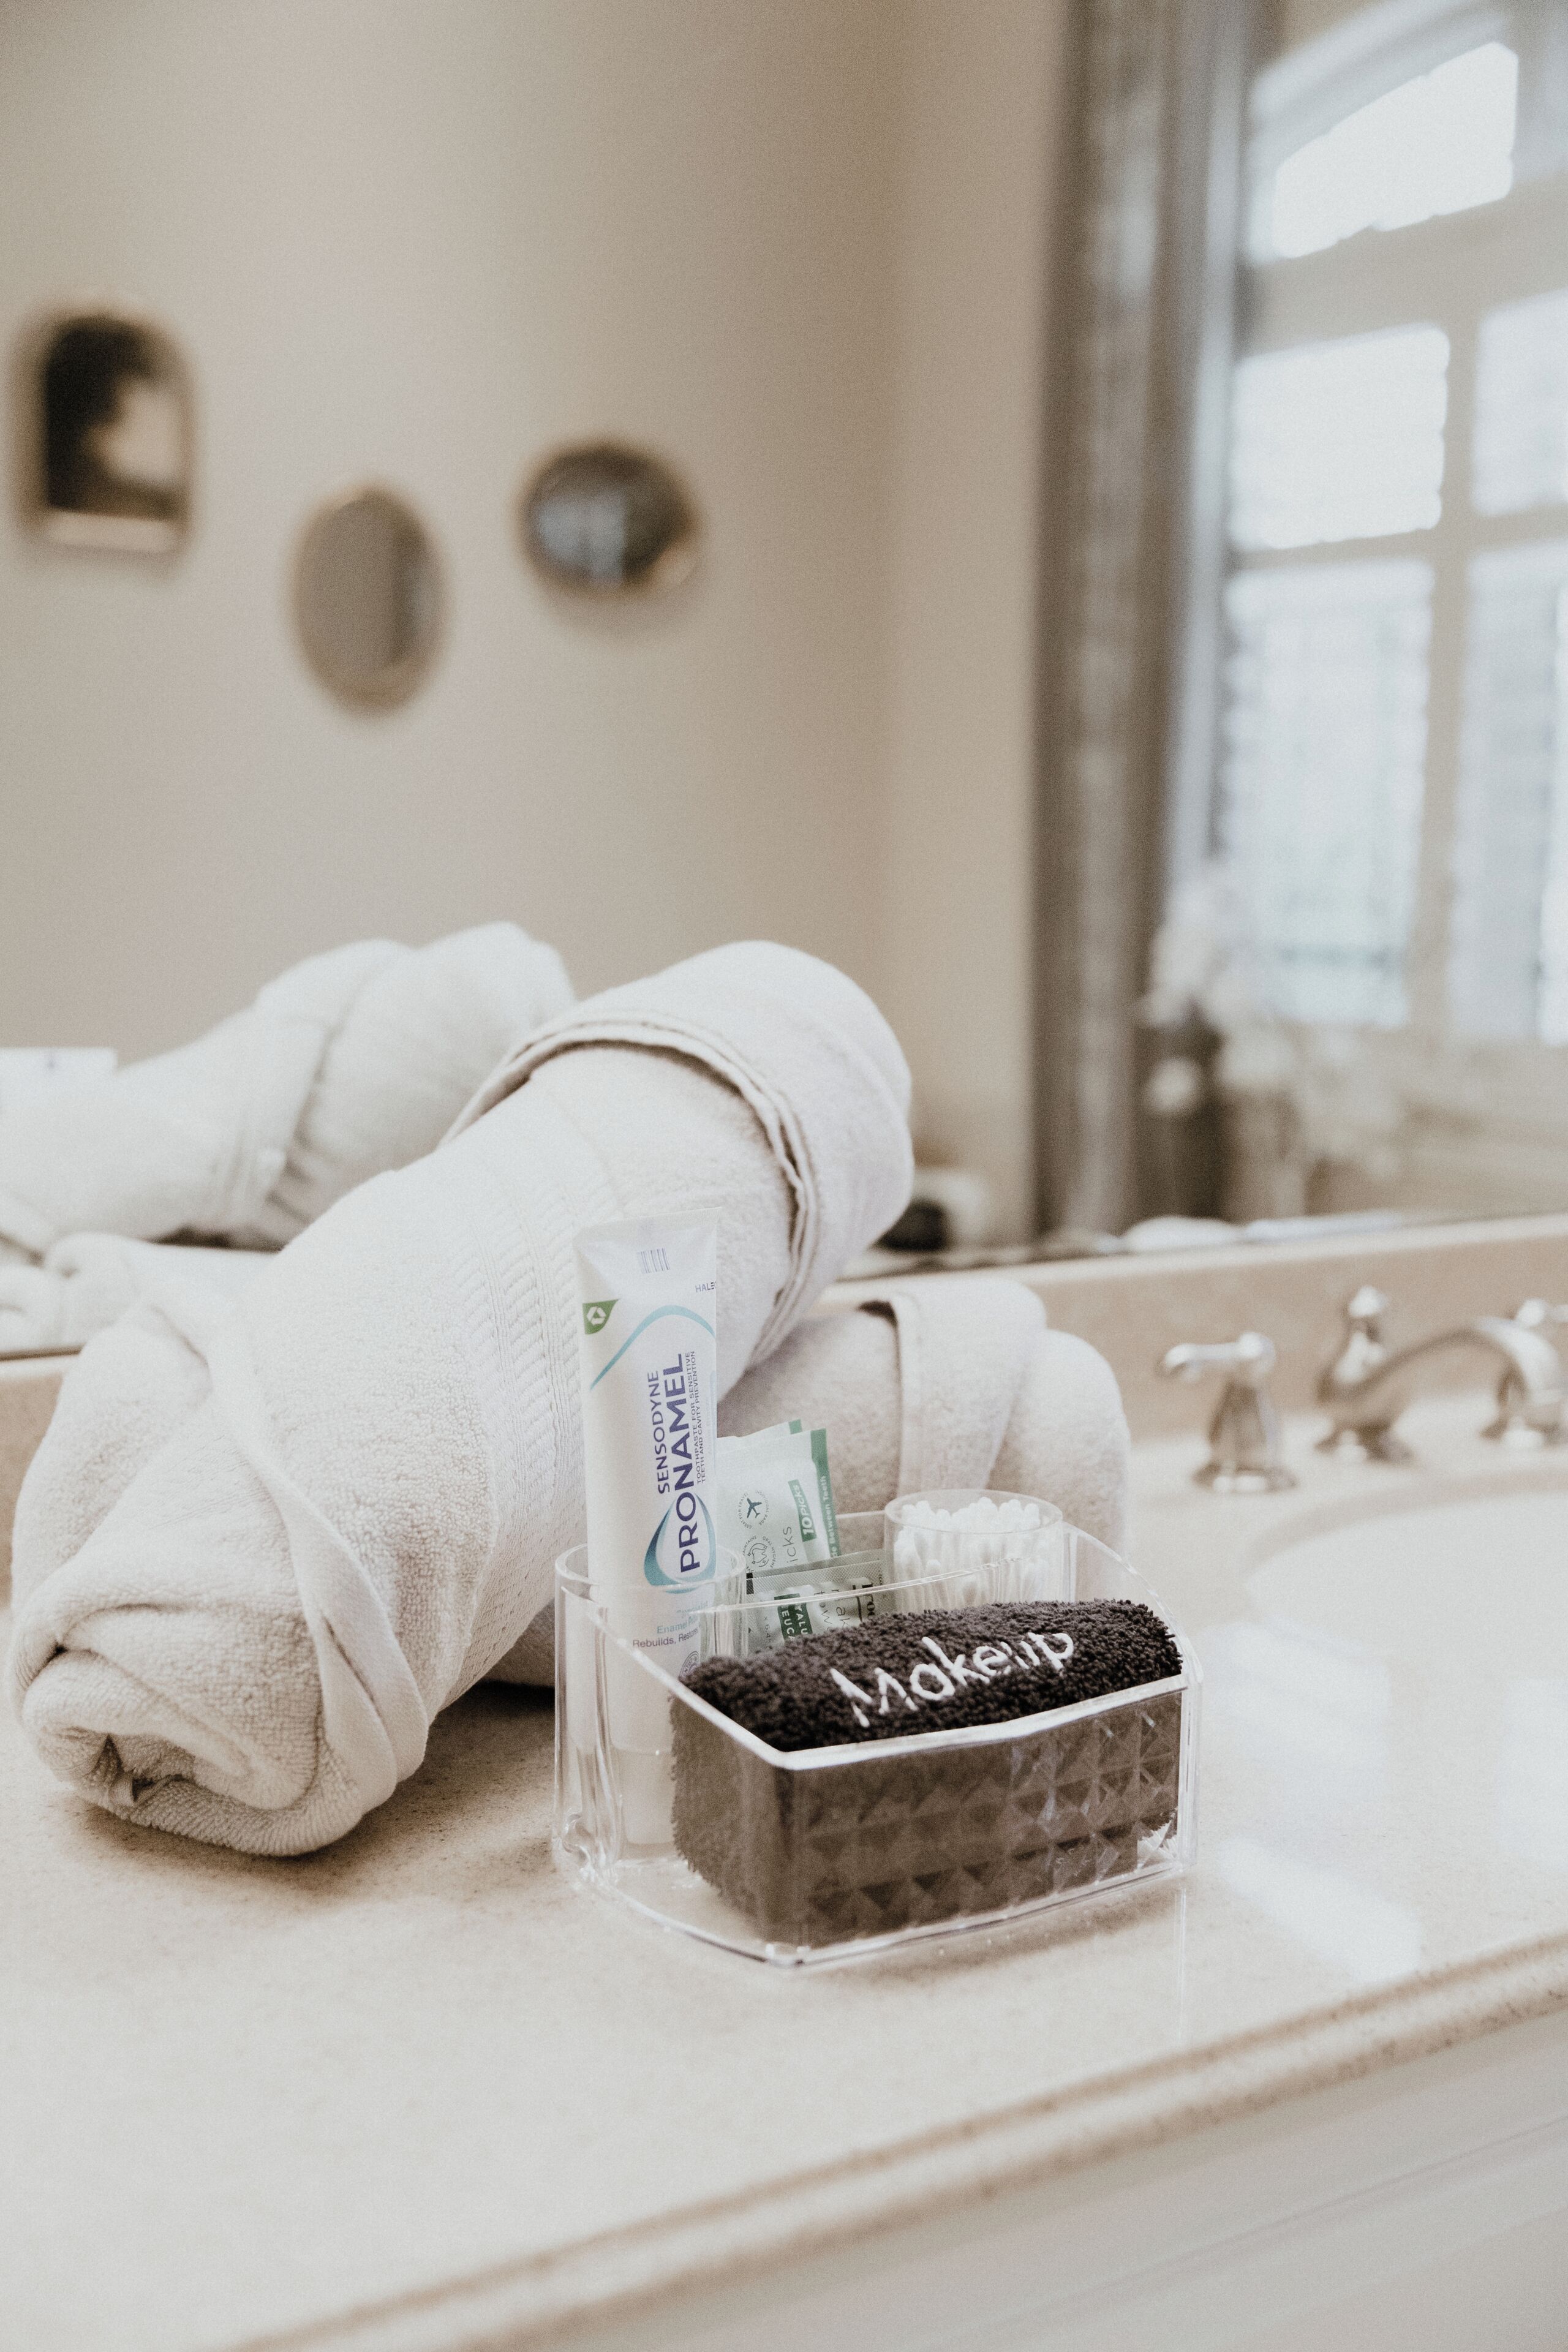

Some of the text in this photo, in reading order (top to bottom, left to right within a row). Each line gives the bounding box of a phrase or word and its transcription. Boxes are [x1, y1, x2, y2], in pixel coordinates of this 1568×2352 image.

[685, 1352, 695, 1399] SENSITIVE
[691, 1351, 699, 1404] PREVENTION
[647, 1371, 670, 1494] SENSODYNE
[663, 1354, 700, 1573] PRONAMEL
[693, 1424, 702, 1485] TOOTHPASTE
[763, 1536, 772, 1546] ORAL
[782, 1526, 798, 1562] icks
[826, 1504, 835, 1544] Between
[781, 1608, 796, 1642] EUCA
[795, 1604, 808, 1634] YALU
[633, 1637, 677, 1648] Rebuilds,
